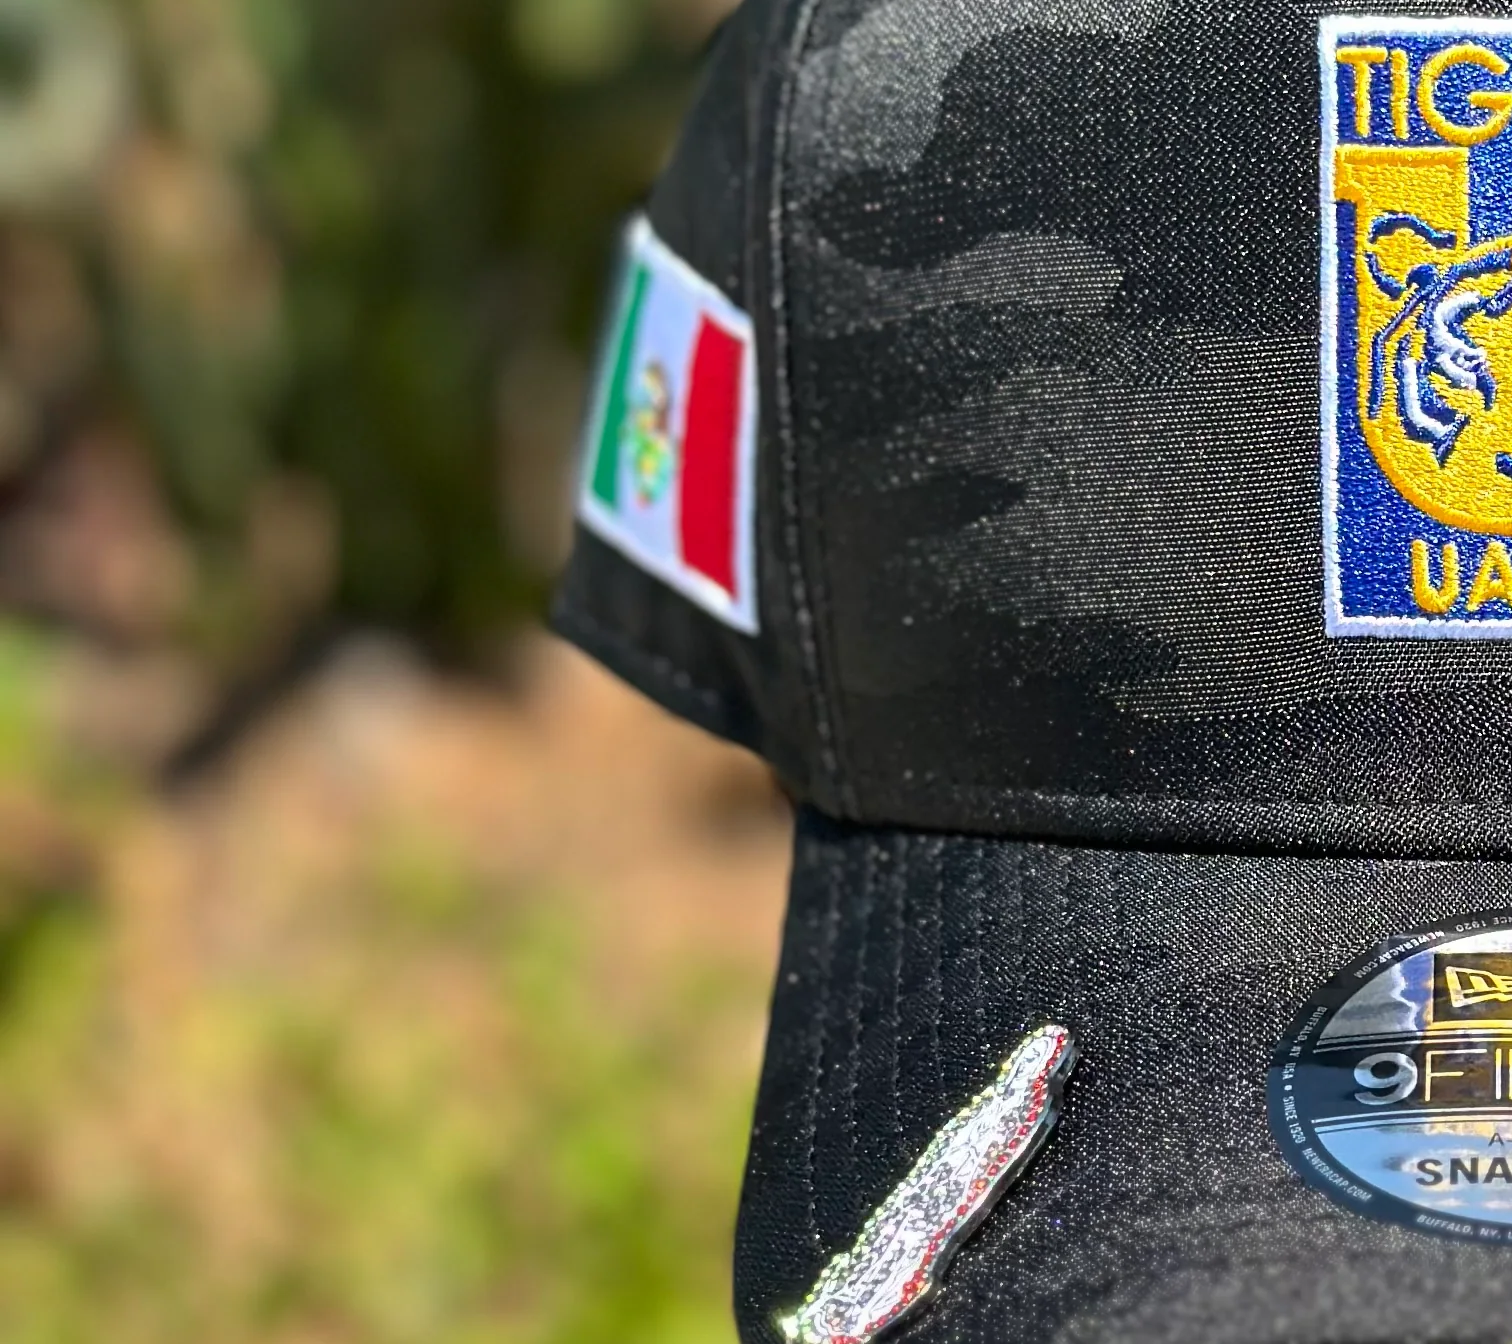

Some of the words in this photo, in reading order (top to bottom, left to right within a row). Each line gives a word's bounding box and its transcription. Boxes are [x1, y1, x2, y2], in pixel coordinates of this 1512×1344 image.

[1456, 920, 1487, 932] 1920
[1354, 931, 1445, 979] NEWERACAP.COM
[1282, 1062, 1297, 1080] USA
[1283, 1095, 1298, 1121] SINCE
[1302, 1147, 1373, 1202] NEWERACAP.COM
